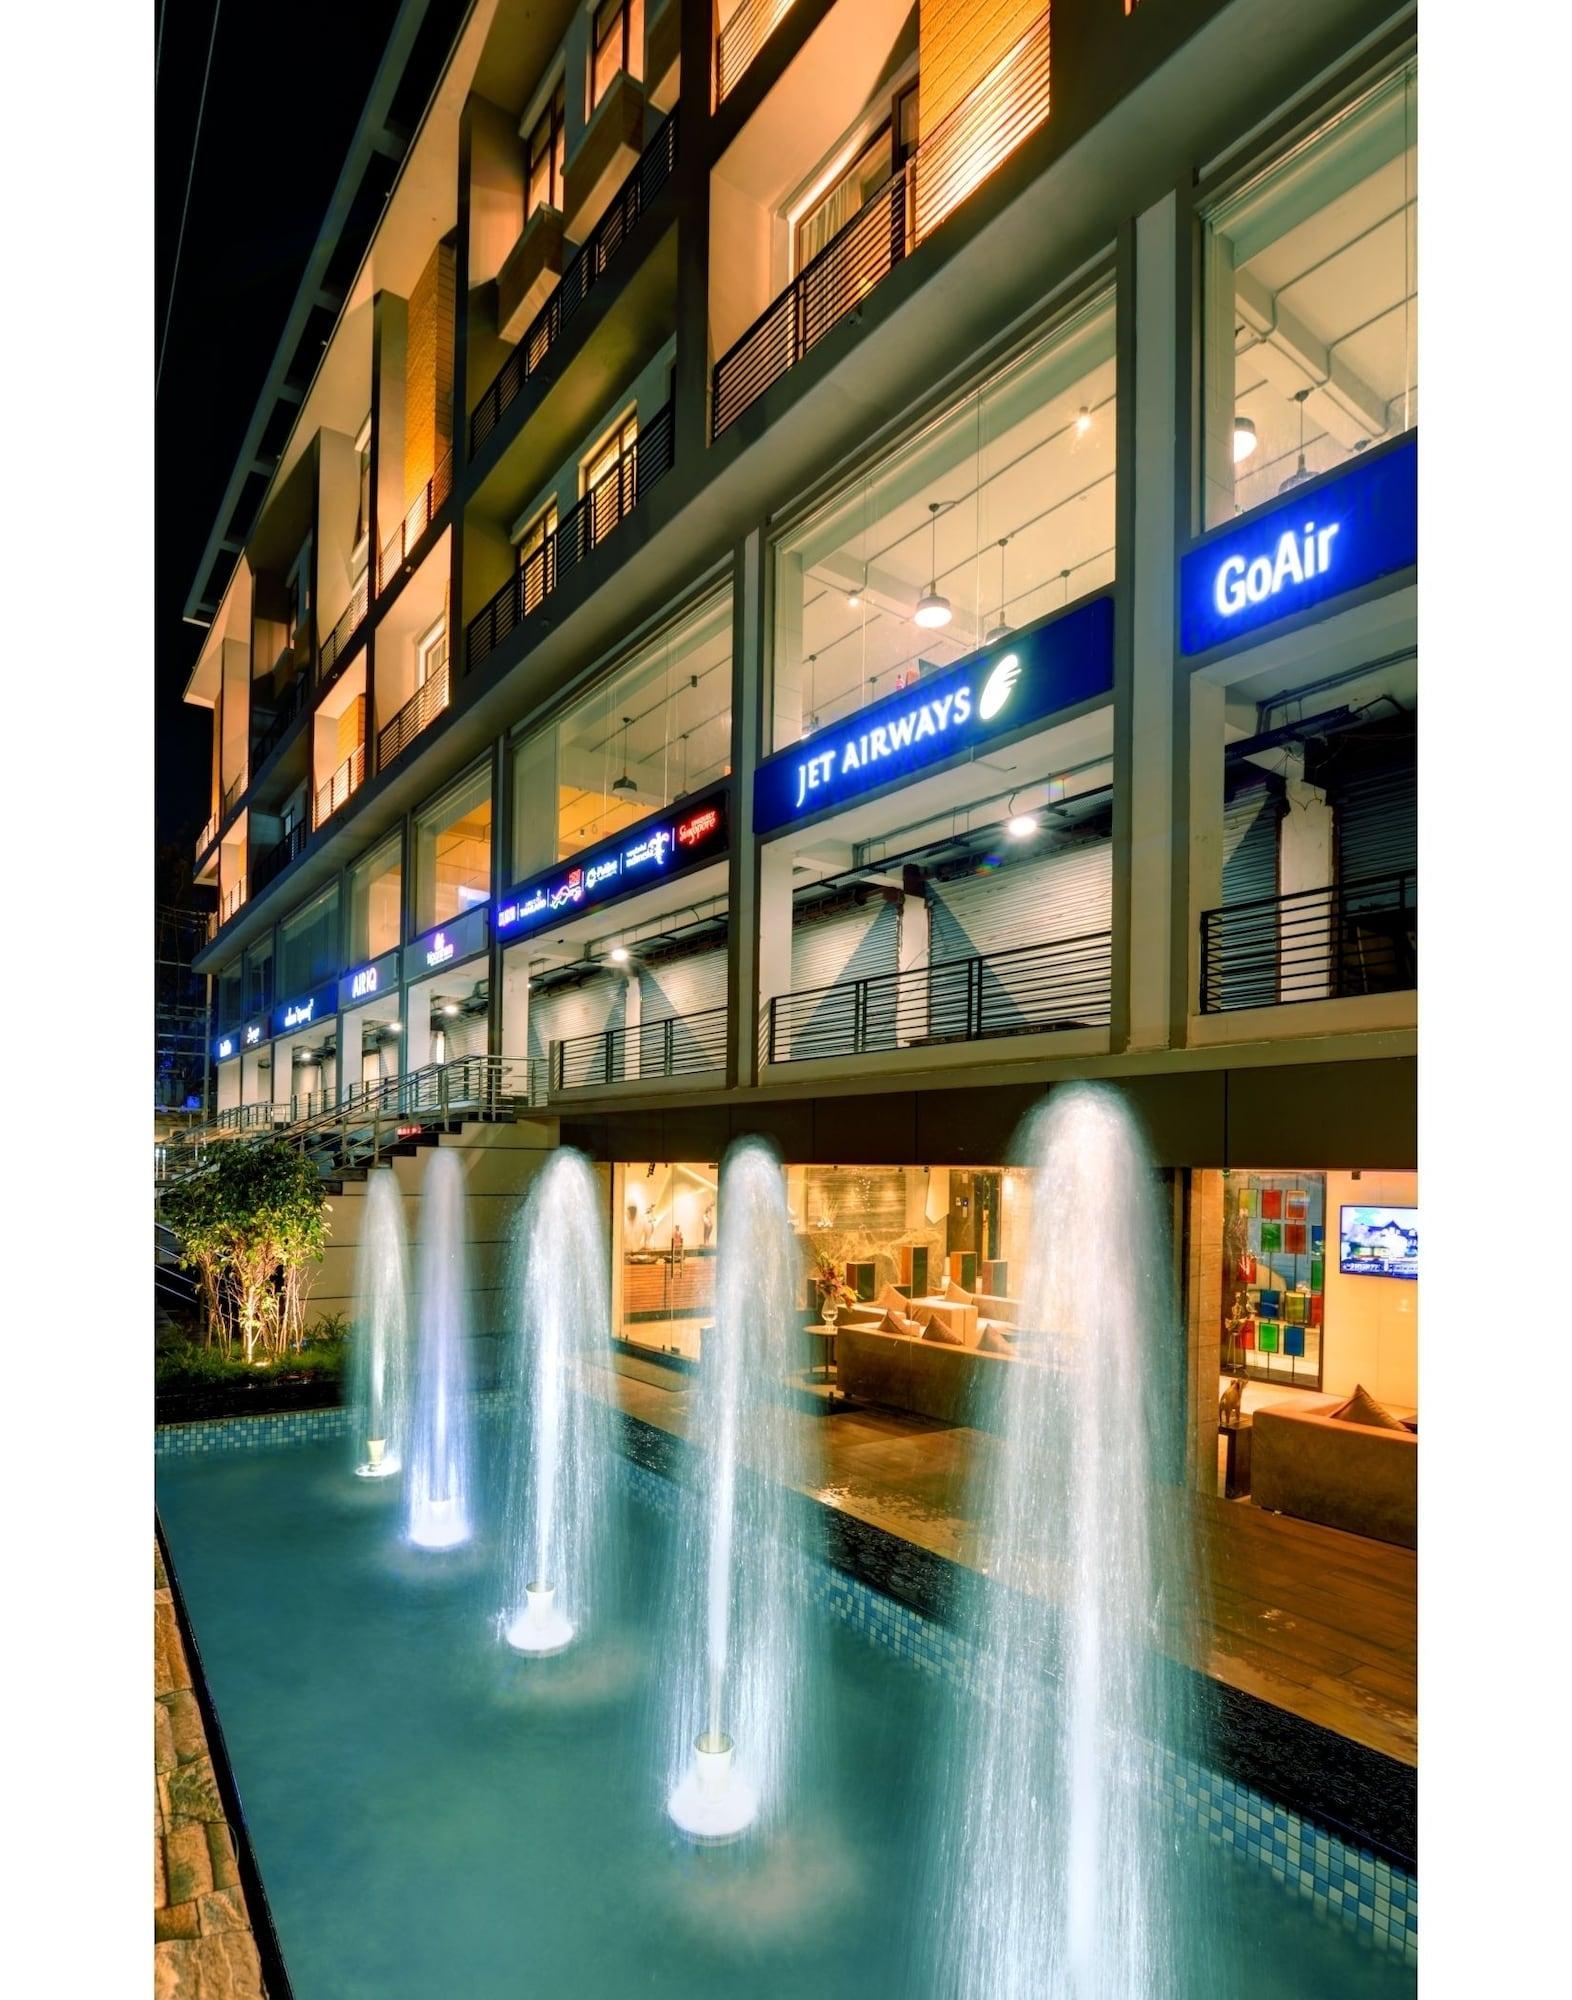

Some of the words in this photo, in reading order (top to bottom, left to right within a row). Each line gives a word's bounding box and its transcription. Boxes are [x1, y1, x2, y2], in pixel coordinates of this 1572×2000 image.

[1215, 521, 1340, 616] GoAir
[796, 749, 837, 808] JET
[841, 686, 971, 774] AIRWAYS
